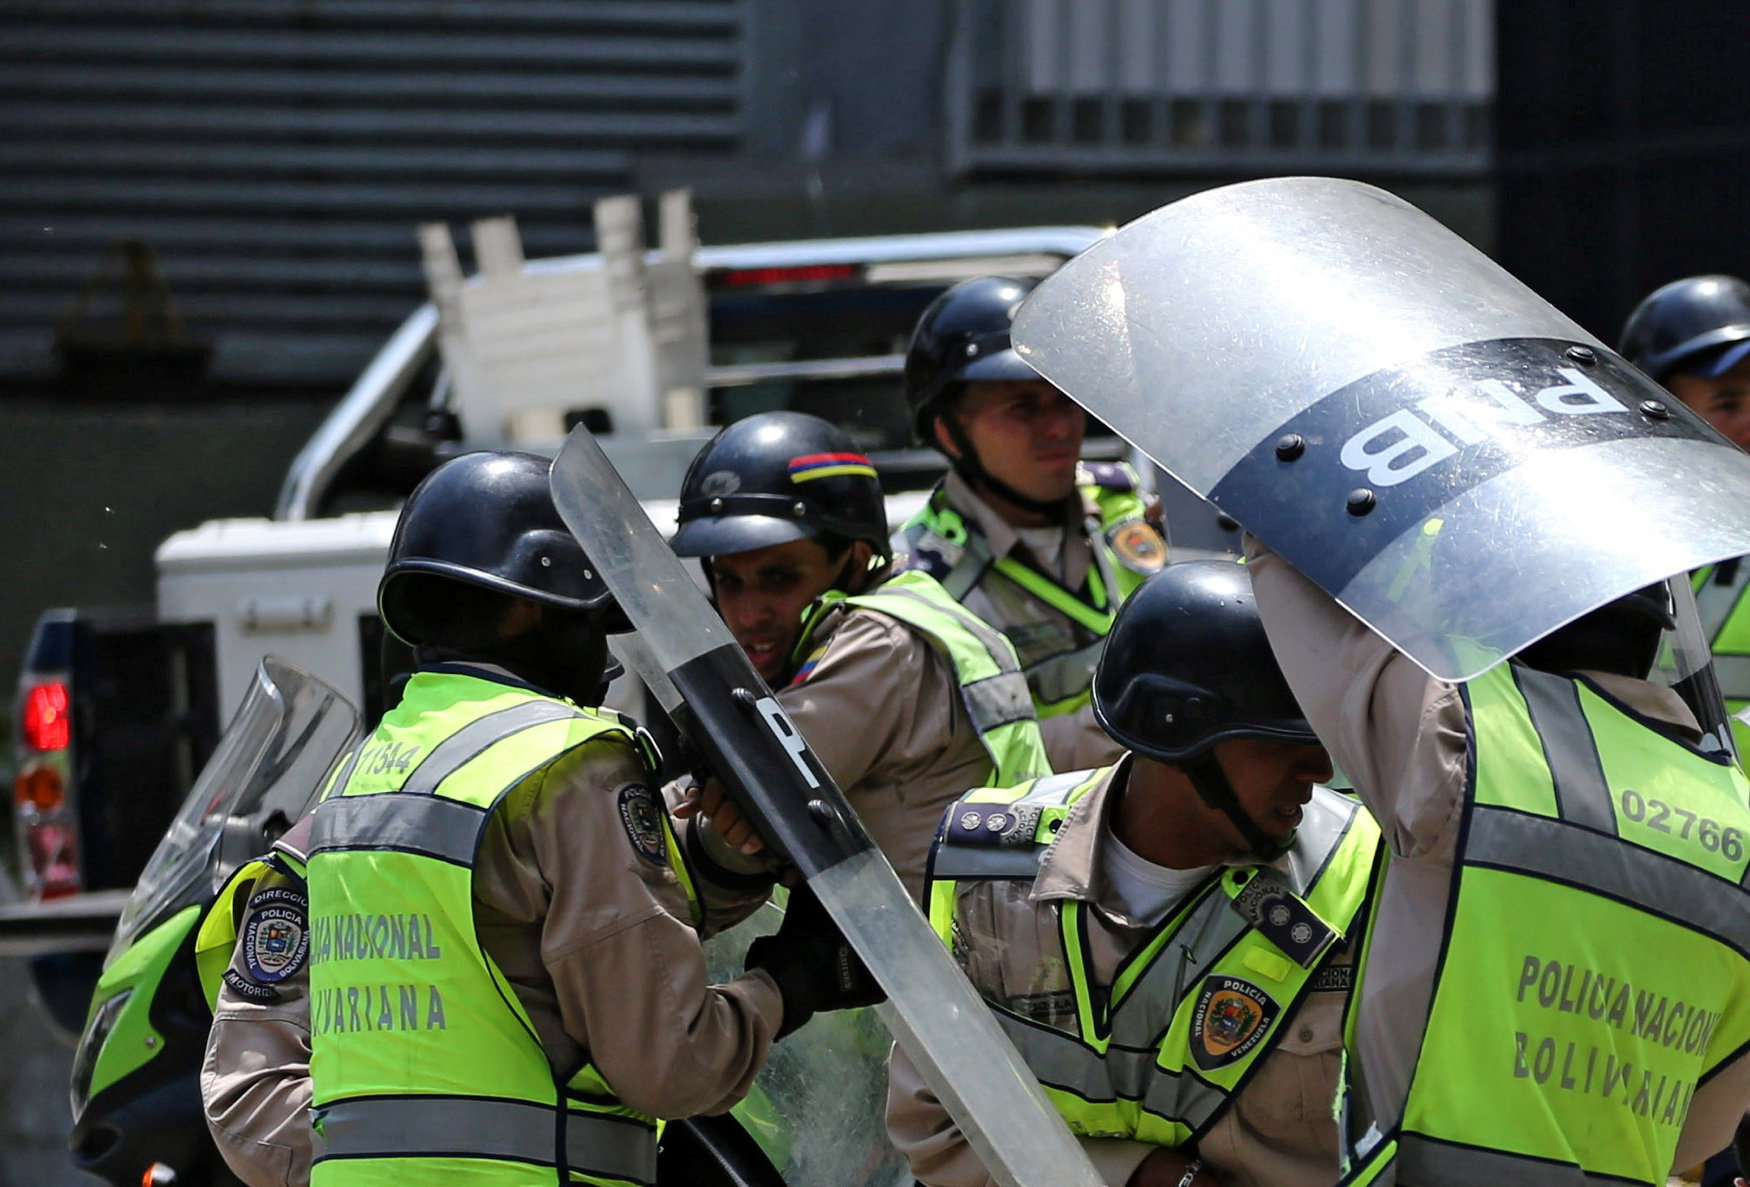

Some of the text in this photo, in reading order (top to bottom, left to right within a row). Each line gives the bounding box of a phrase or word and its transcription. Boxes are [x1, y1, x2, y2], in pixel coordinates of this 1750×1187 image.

[1340, 367, 1631, 487] PNB
[1621, 789, 1743, 862] 02766
[260, 908, 303, 925] POLICIA
[334, 912, 441, 961] NACIONAL
[246, 921, 259, 970] NACIONAL
[1195, 991, 1212, 1037] NACIONAL
[1223, 980, 1267, 1007] POLICIA
[1516, 954, 1631, 1030] POLICIA
[1231, 1016, 1270, 1058] VENEZUELA
